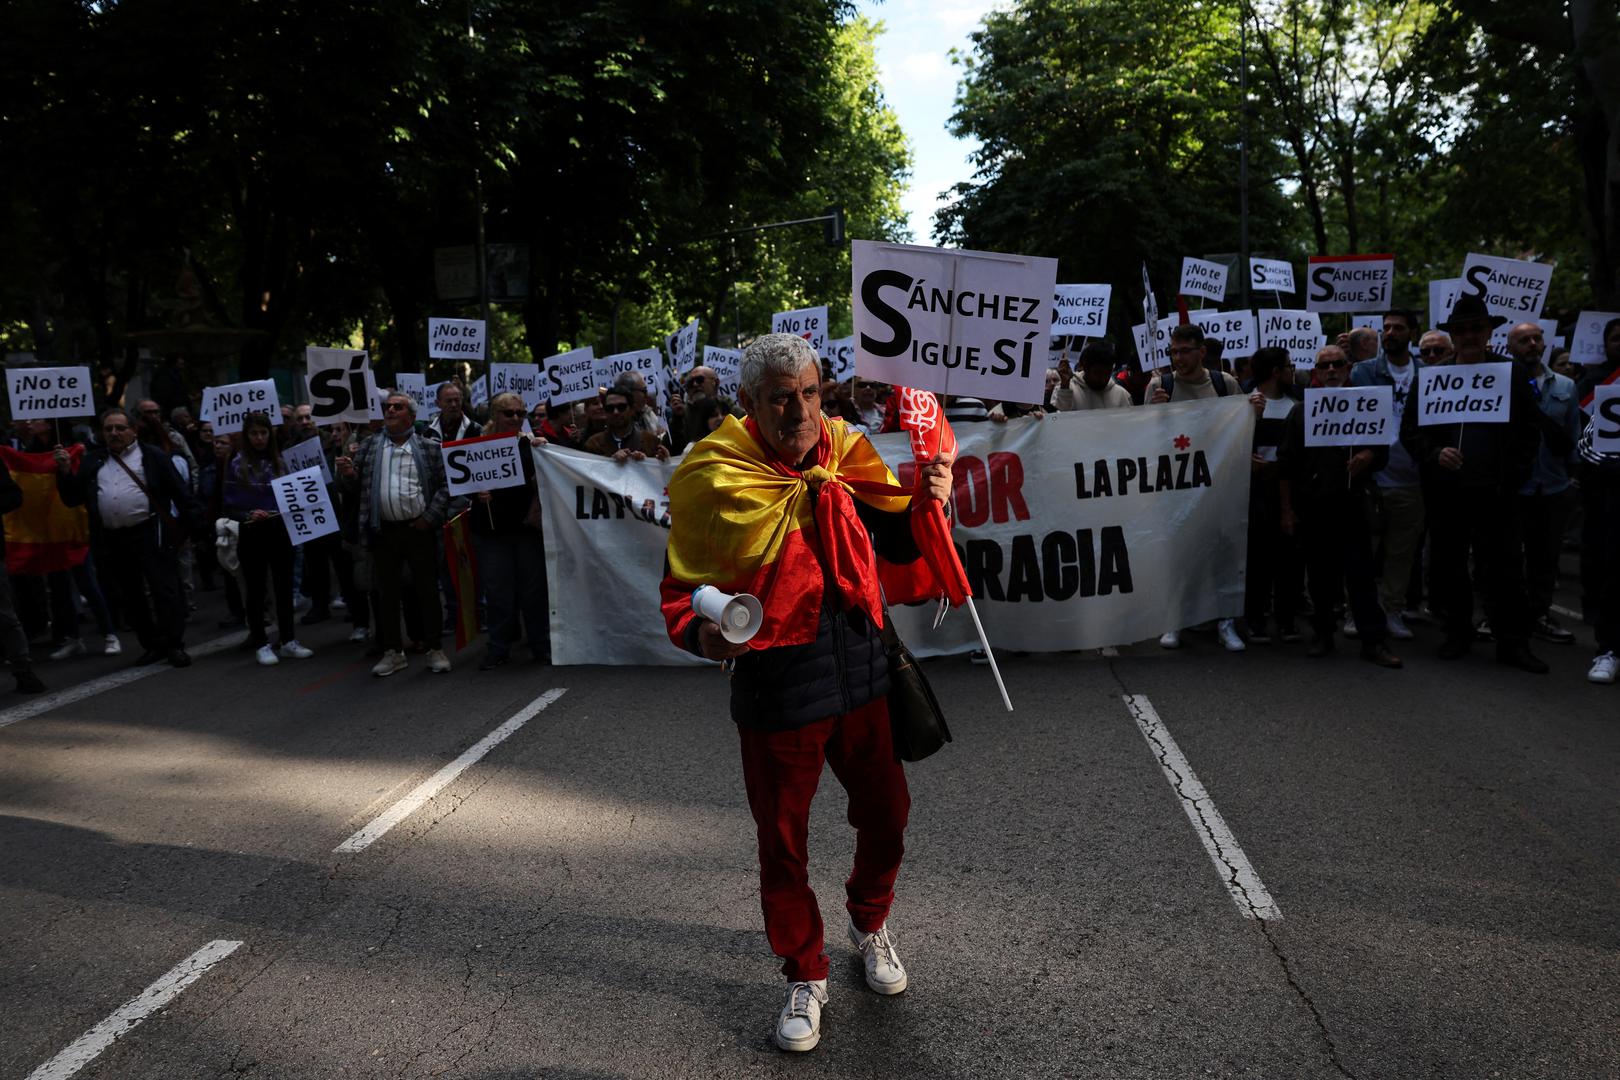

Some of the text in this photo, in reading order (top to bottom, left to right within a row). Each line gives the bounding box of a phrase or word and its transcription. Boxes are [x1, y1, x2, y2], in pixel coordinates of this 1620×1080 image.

[1186, 264, 1221, 280] ¡No te
[1184, 278, 1222, 295] rindas!
[860, 270, 1040, 357] SÁNCHEZ
[433, 324, 477, 338] ¡No te
[805, 317, 818, 330] te
[1226, 320, 1242, 331] te
[1265, 316, 1311, 333] ¡No te
[434, 340, 480, 353] rindas!
[1267, 336, 1317, 350] rindas!
[610, 358, 652, 376] ¡No te
[728, 356, 739, 366] te
[15, 375, 78, 394] ¡No te
[309, 354, 370, 417] SÍ
[510, 373, 535, 394] sigue!
[1425, 373, 1496, 396] ¡No te
[18, 394, 87, 411] rindas!
[213, 390, 265, 412] ¡No te
[1312, 396, 1378, 417] ¡No te
[1425, 396, 1503, 415] rindas!
[1312, 418, 1386, 436] rindas!
[447, 446, 514, 485] SÁNCHEZ
[281, 482, 312, 536] rindas!
[297, 476, 319, 503] ¡No
[312, 508, 326, 526] te
